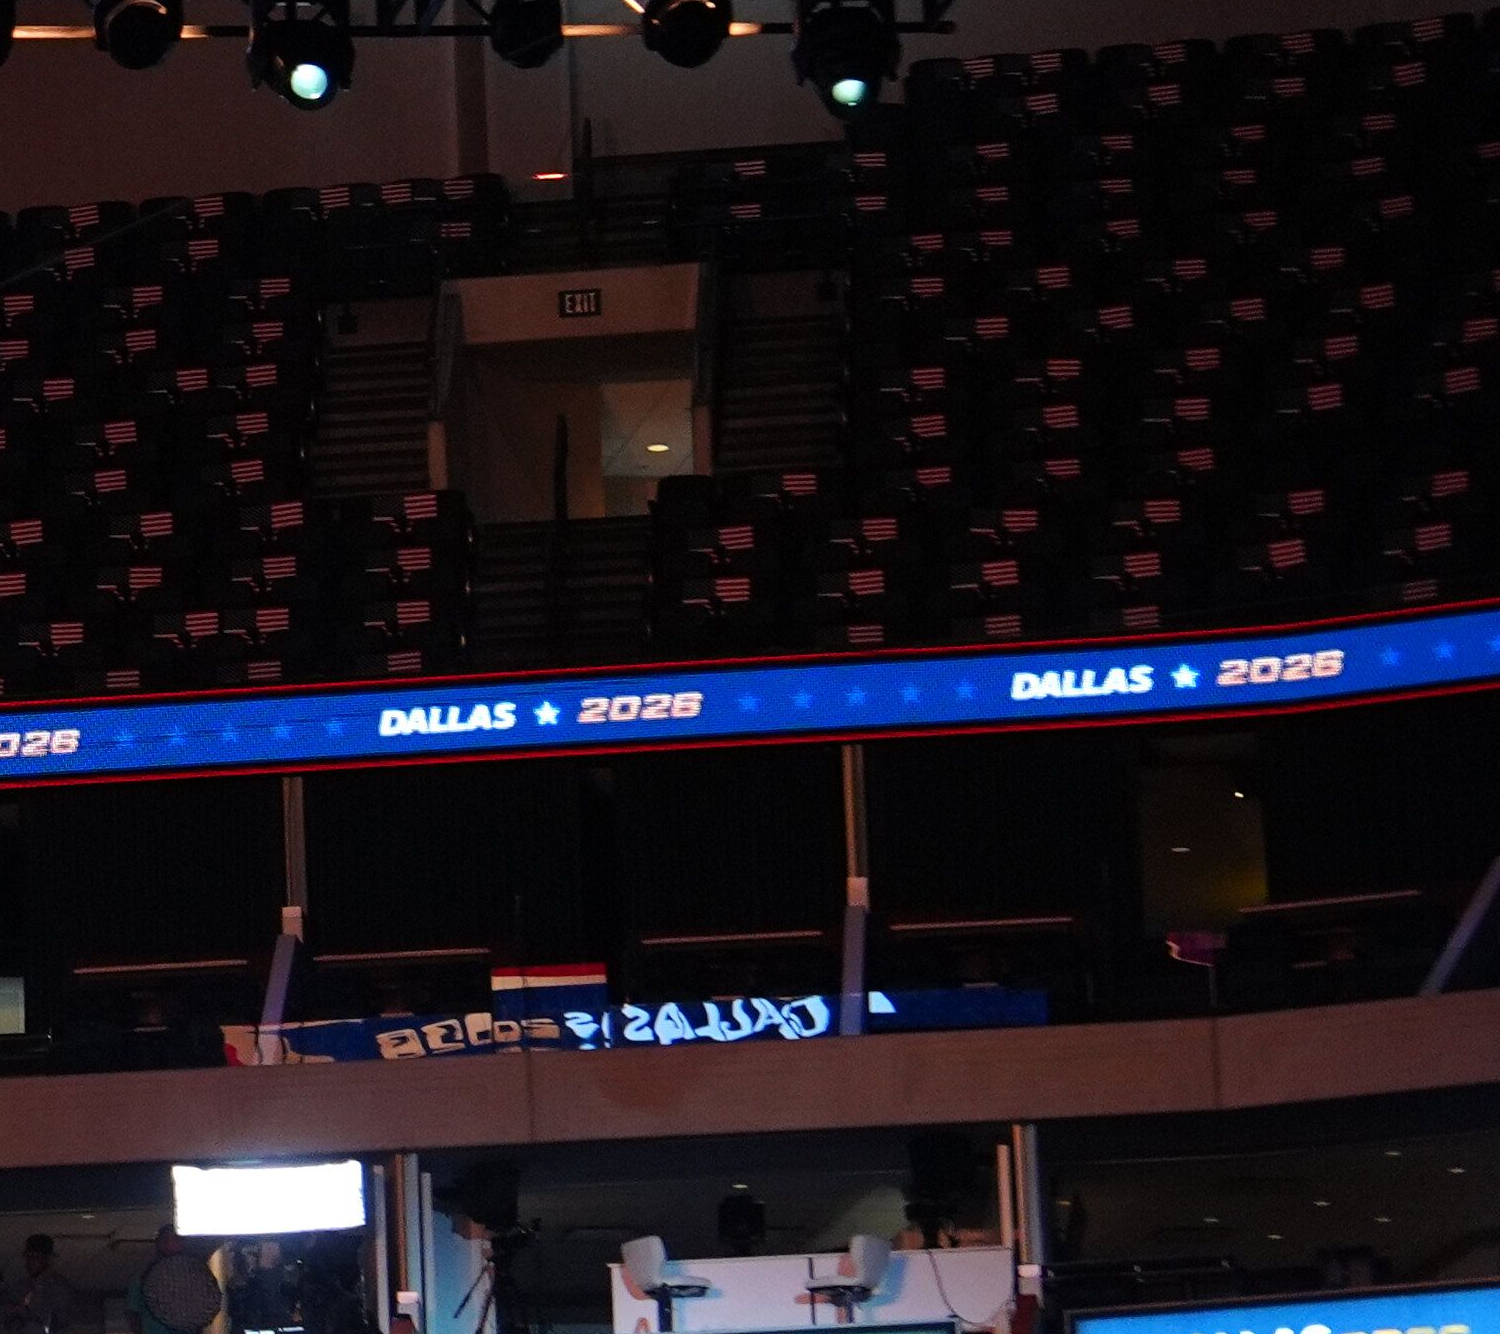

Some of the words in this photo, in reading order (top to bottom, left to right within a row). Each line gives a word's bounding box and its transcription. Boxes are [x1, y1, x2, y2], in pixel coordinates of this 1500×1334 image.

[564, 294, 596, 315] EXIT
[1011, 666, 1153, 699] DALLAS
[1217, 650, 1344, 685] 2026
[380, 703, 516, 736] DALLAS
[578, 692, 703, 723] 2026
